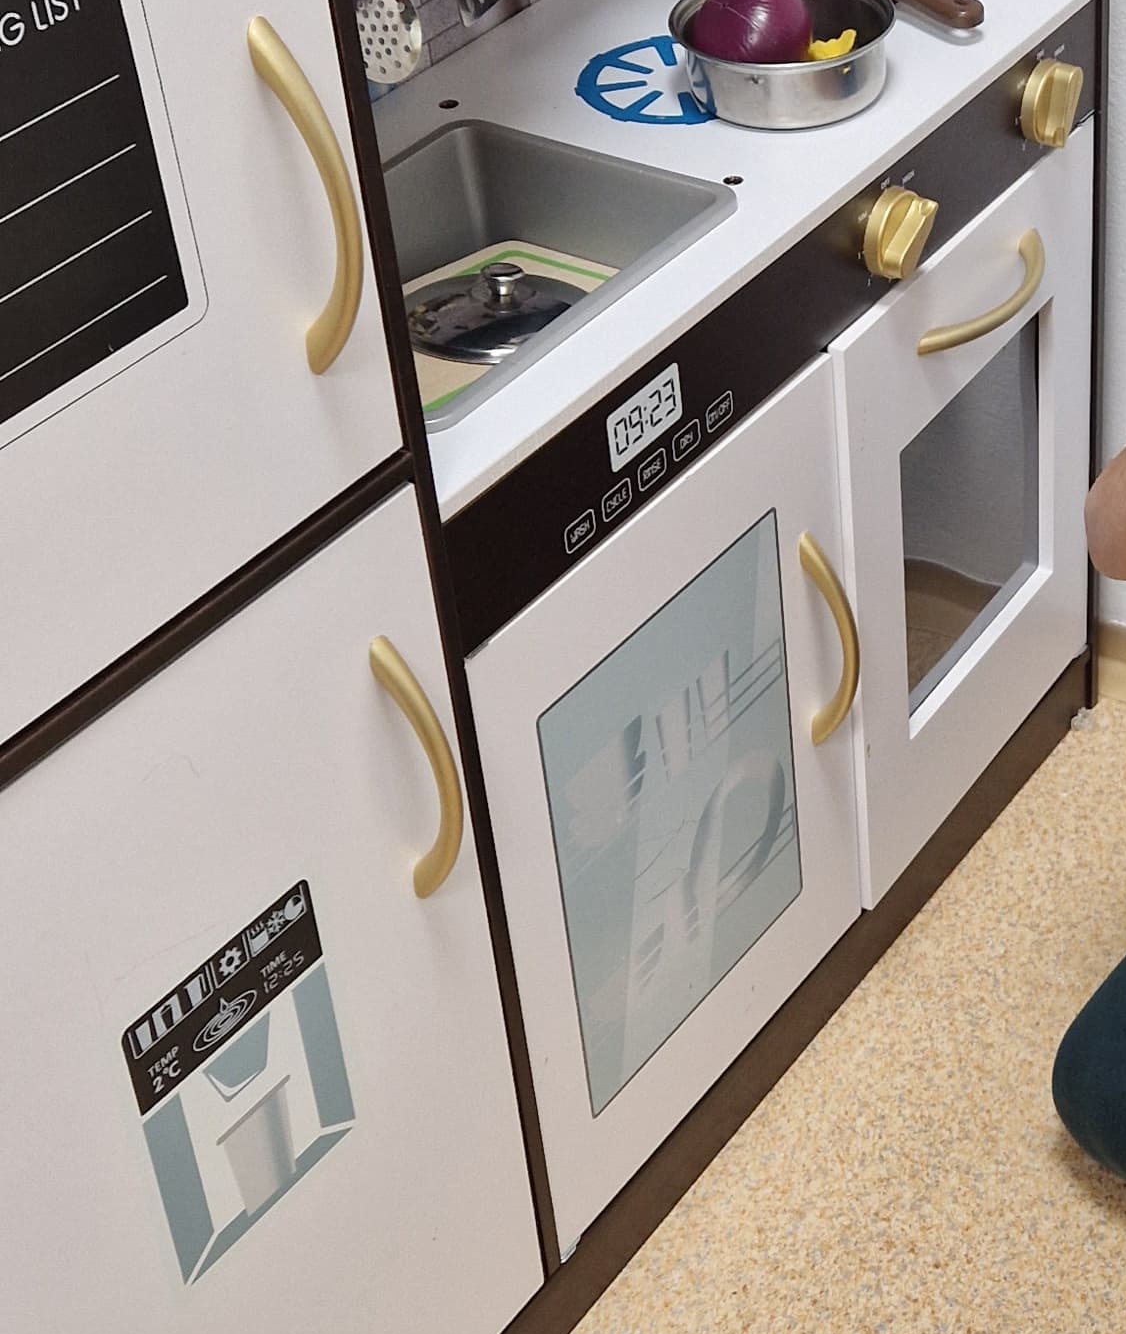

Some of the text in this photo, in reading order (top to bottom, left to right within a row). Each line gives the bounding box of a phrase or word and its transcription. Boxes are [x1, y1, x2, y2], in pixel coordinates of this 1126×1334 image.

[614, 378, 677, 456] 09:23
[606, 487, 628, 513] CYCLE
[260, 950, 287, 977] TIME
[263, 950, 305, 994] 12:25
[147, 1046, 179, 1077] TEMP
